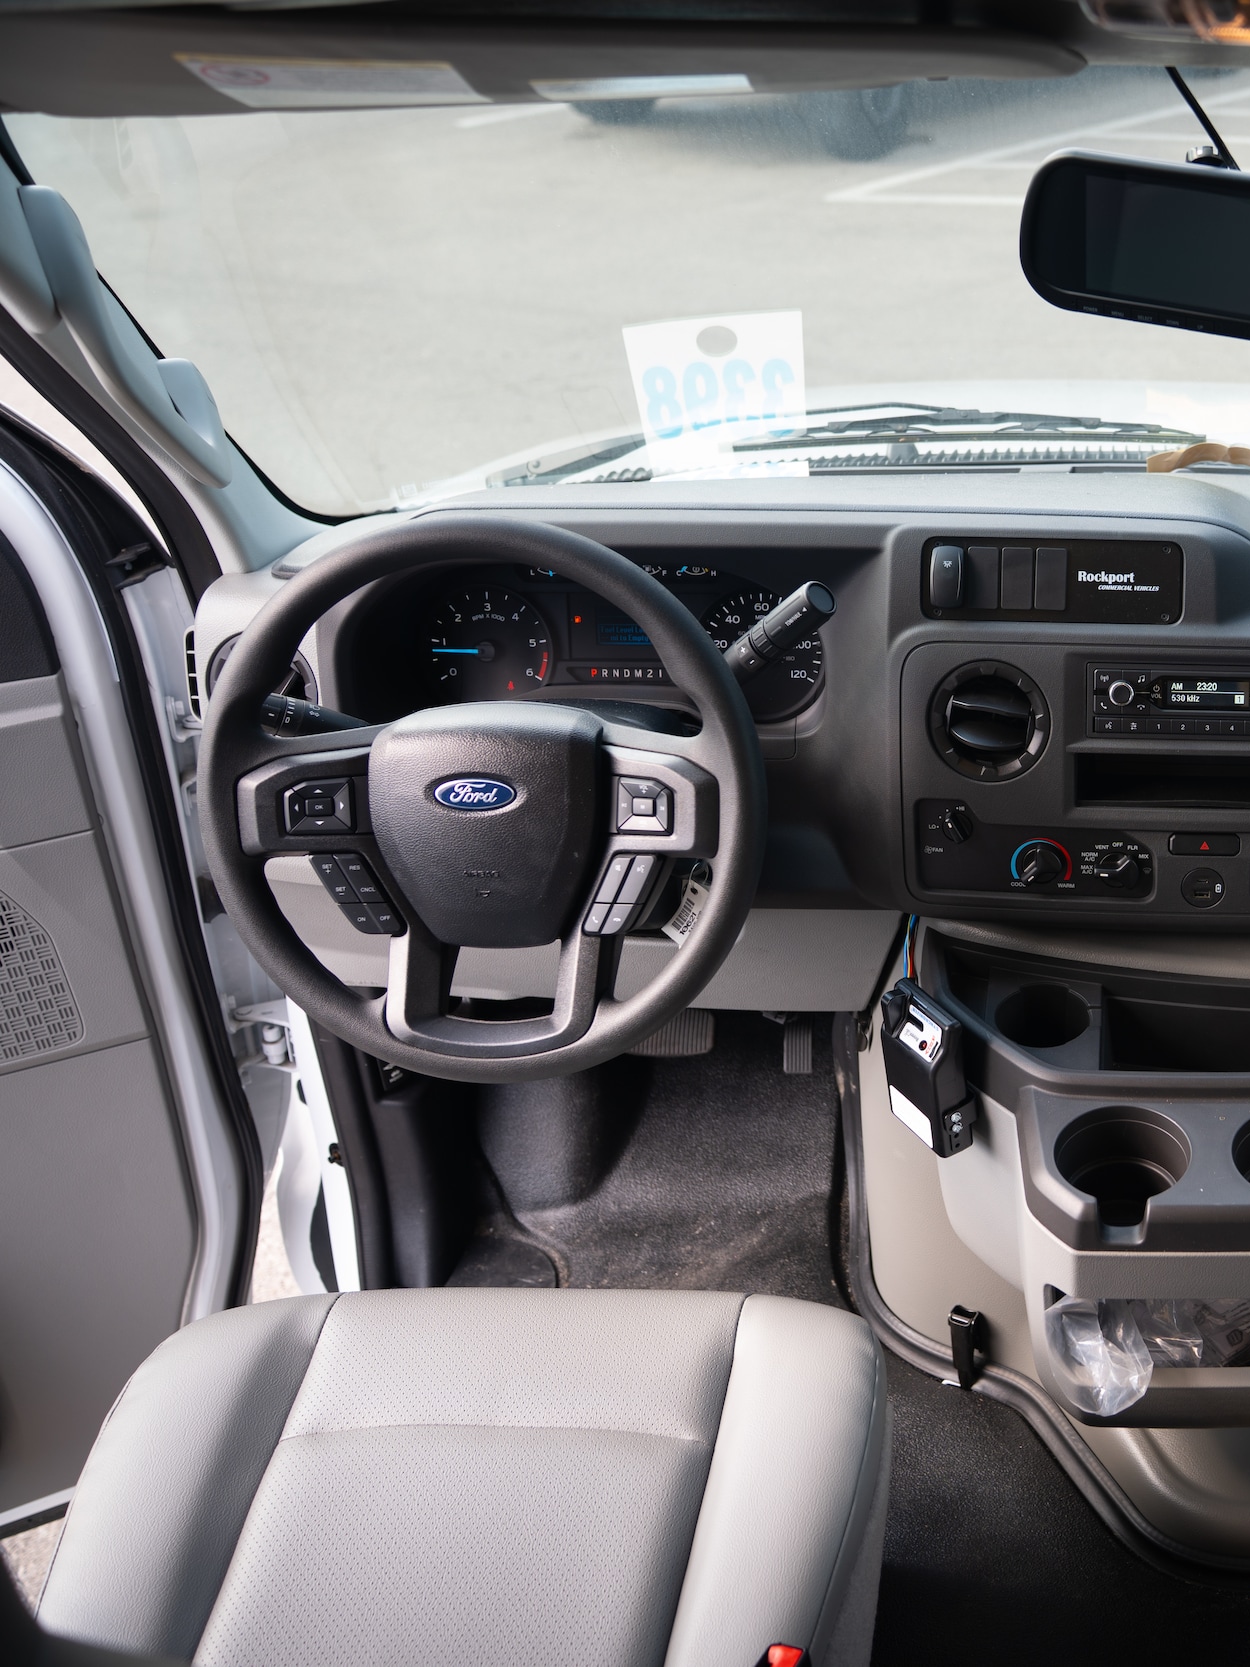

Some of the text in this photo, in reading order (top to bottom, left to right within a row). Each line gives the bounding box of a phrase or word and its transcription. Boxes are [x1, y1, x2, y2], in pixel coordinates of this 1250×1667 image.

[1077, 570, 1135, 584] Rockport
[1098, 584, 1133, 592] COMMERCIAL
[484, 603, 491, 611] 3
[754, 603, 770, 612] 60
[454, 613, 462, 622] 2
[490, 613, 506, 621] 1000
[511, 613, 519, 621] 4
[725, 615, 741, 624] 40
[529, 638, 536, 647] 5
[713, 640, 728, 649] 20
[795, 640, 812, 649] 00
[449, 667, 458, 676] 0
[525, 668, 534, 677] 6
[591, 668, 598, 678] P
[601, 668, 609, 678] R
[612, 668, 620, 678] N
[623, 668, 631, 678] D
[634, 668, 643, 678] M
[646, 668, 654, 678] 2
[790, 669, 807, 679] 120
[1171, 682, 1218, 692] AM 23:20
[1171, 694, 1200, 703] 530 kHz
[1156, 722, 1161, 730] 1
[1180, 723, 1185, 731] 2
[1204, 723, 1210, 731] 3
[449, 783, 499, 804] Ford
[679, 912, 698, 936] 10621
